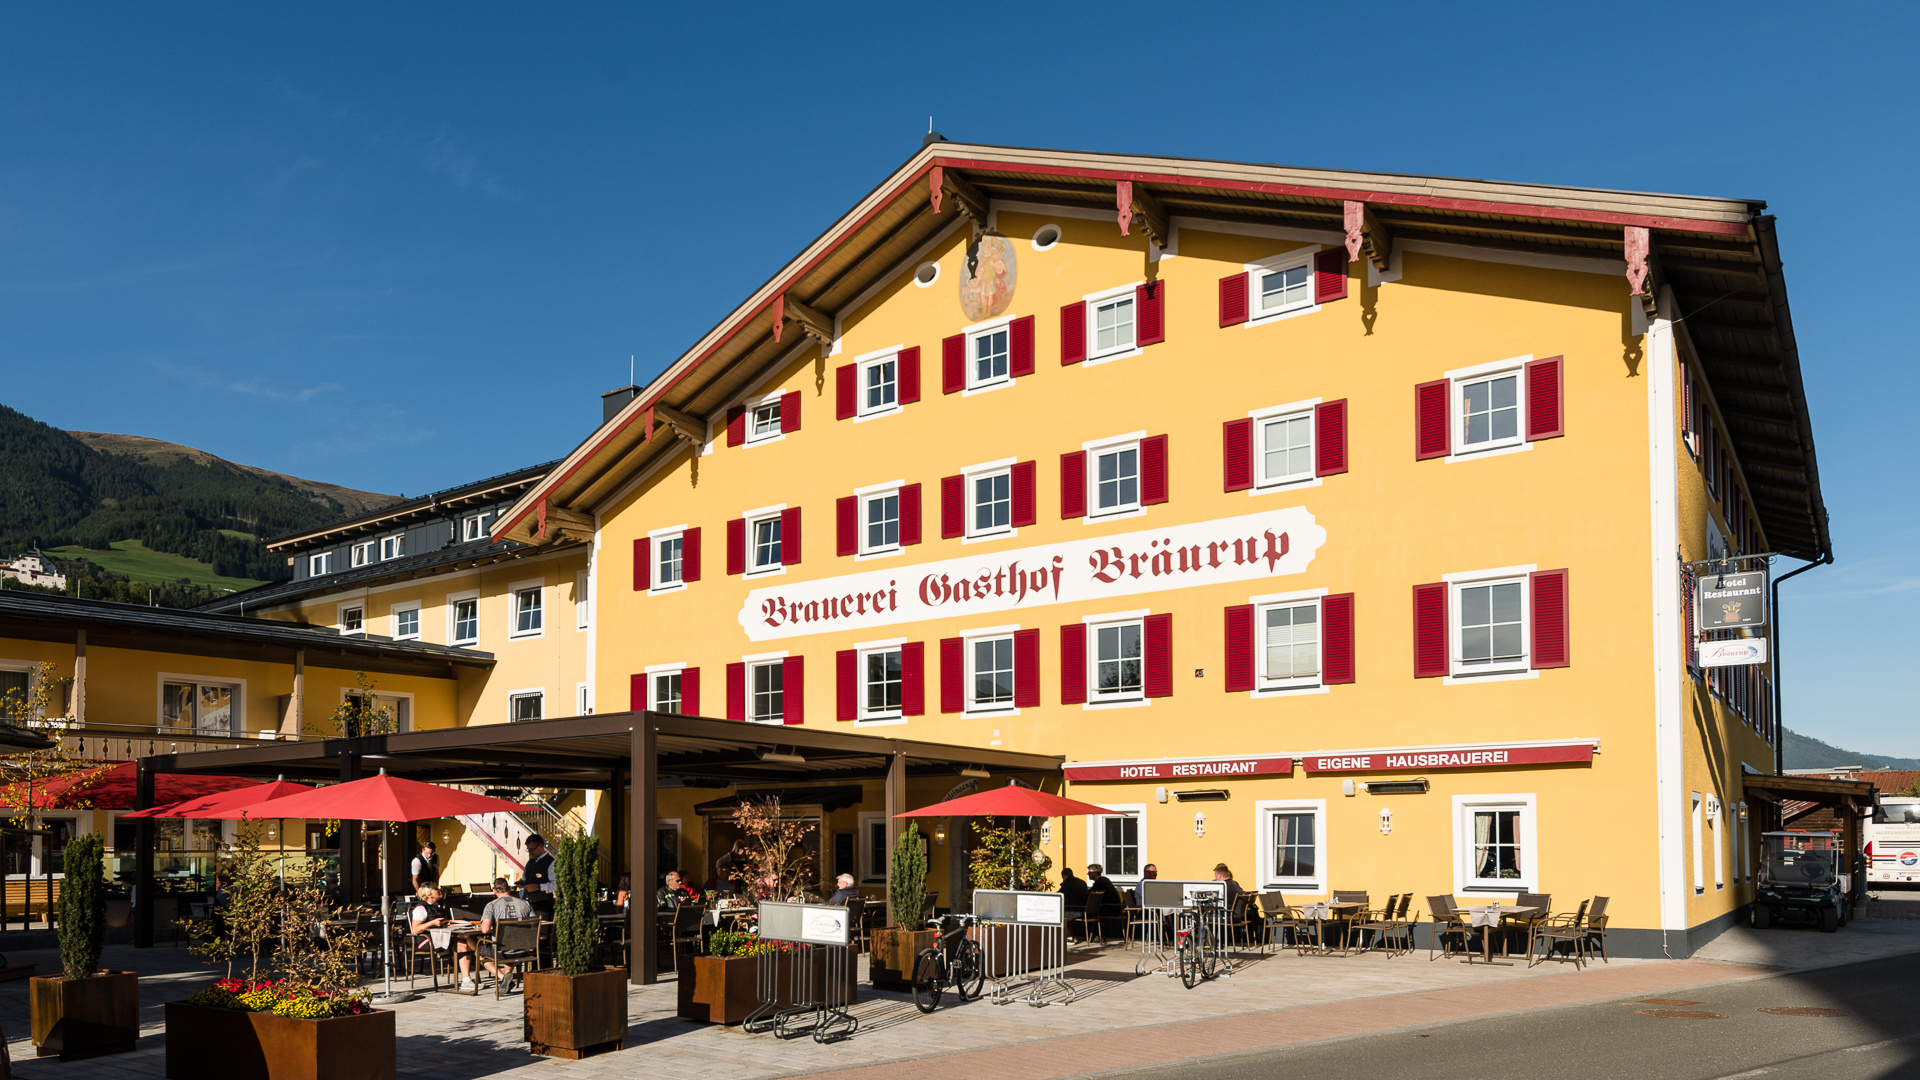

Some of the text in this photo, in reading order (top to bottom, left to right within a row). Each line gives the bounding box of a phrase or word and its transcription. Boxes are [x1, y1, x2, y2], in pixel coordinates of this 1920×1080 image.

[761, 529, 1290, 628] Brauerei Gasthof Bräurup
[1717, 577, 1747, 589] Hotel
[1703, 586, 1762, 599] Restaurant
[1317, 750, 1509, 770] EIGENE HAUSBRAUEREI
[1120, 761, 1258, 778] HOTEL RESTAURANT
